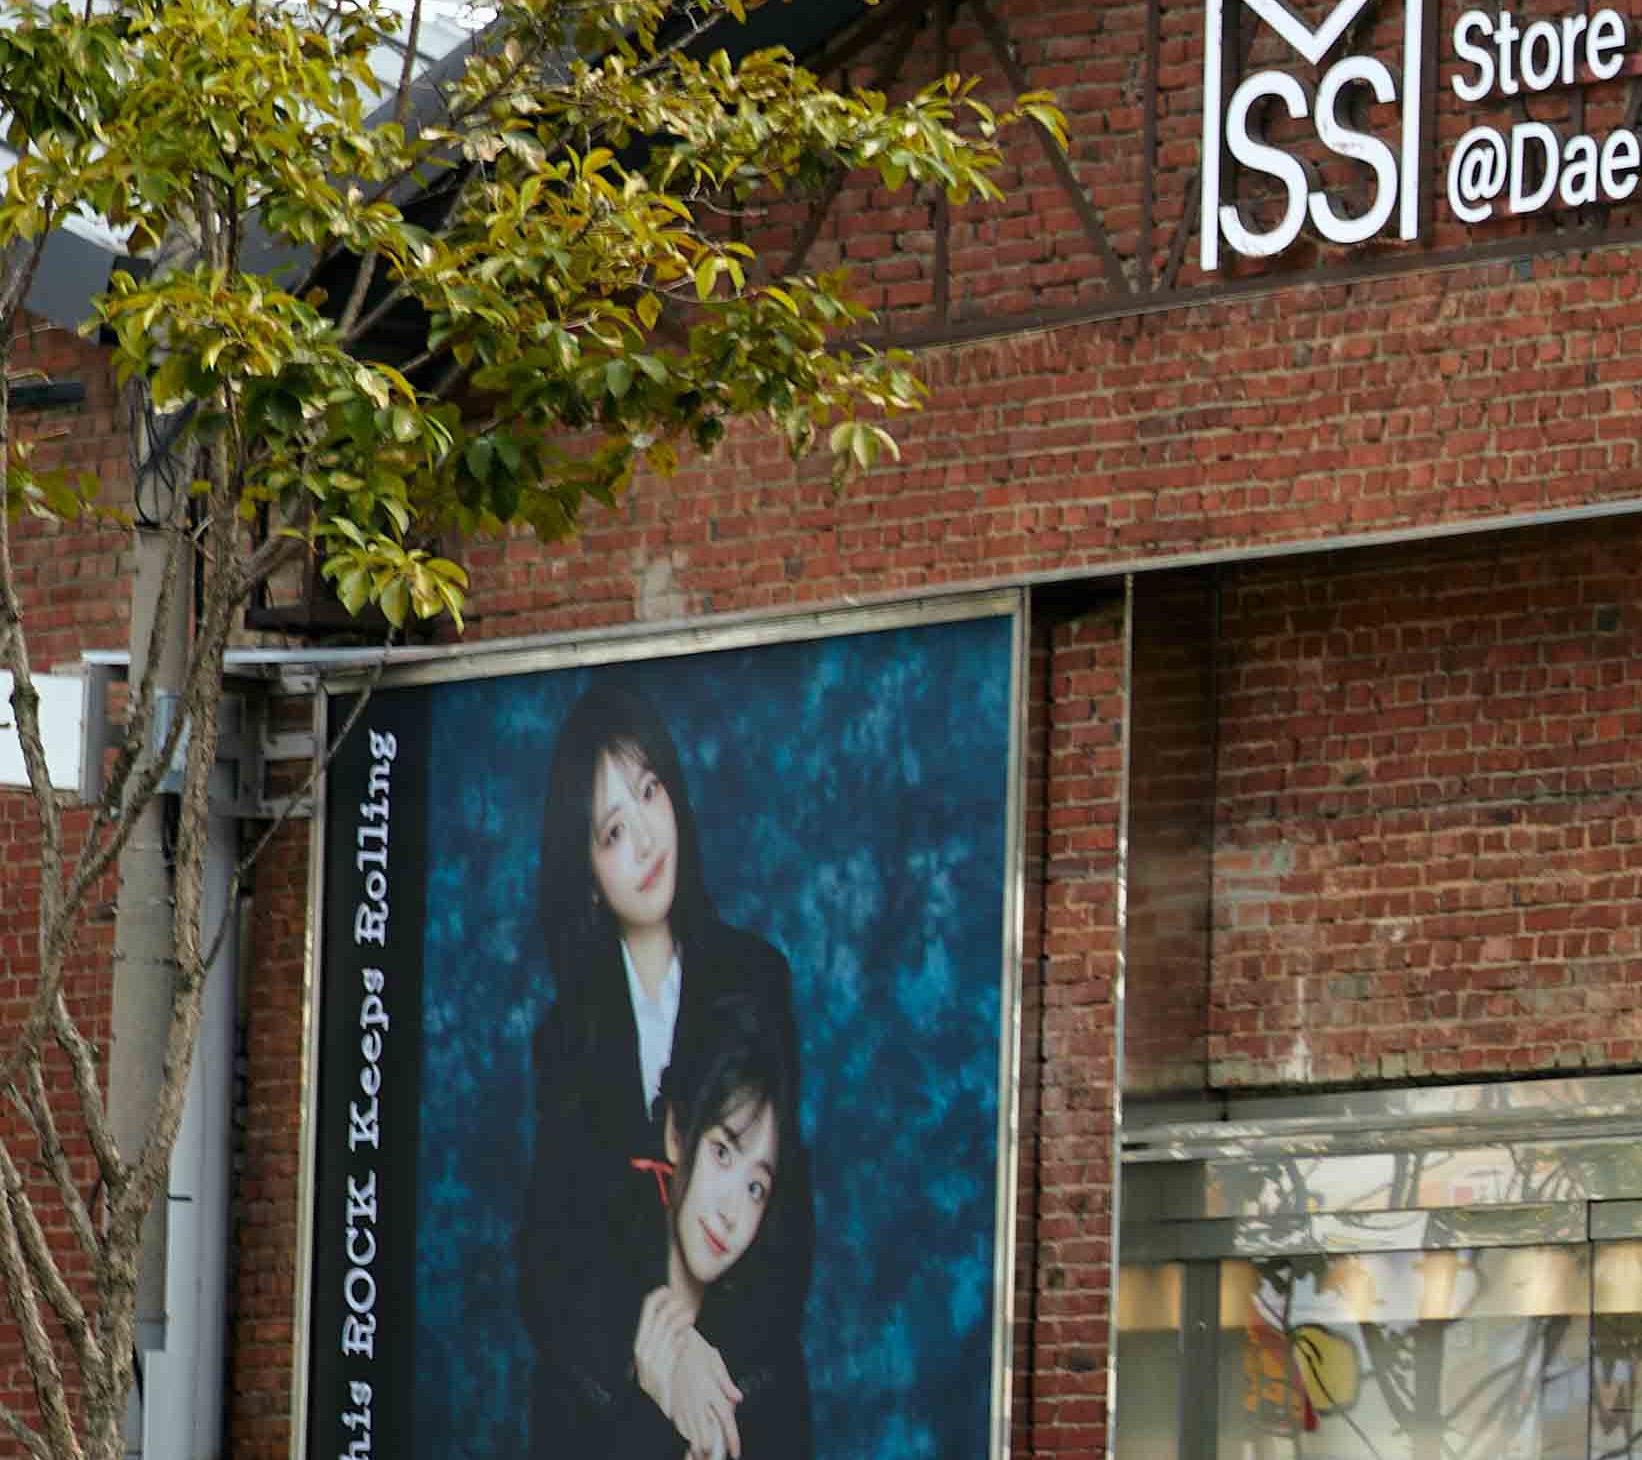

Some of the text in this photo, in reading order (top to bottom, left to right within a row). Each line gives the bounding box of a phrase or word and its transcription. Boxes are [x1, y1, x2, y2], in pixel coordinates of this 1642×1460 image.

[1451, 7, 1626, 103] Store
[353, 727, 398, 948] Rolling
[347, 967, 387, 1150] Keeps
[341, 1171, 377, 1360] ROCK
